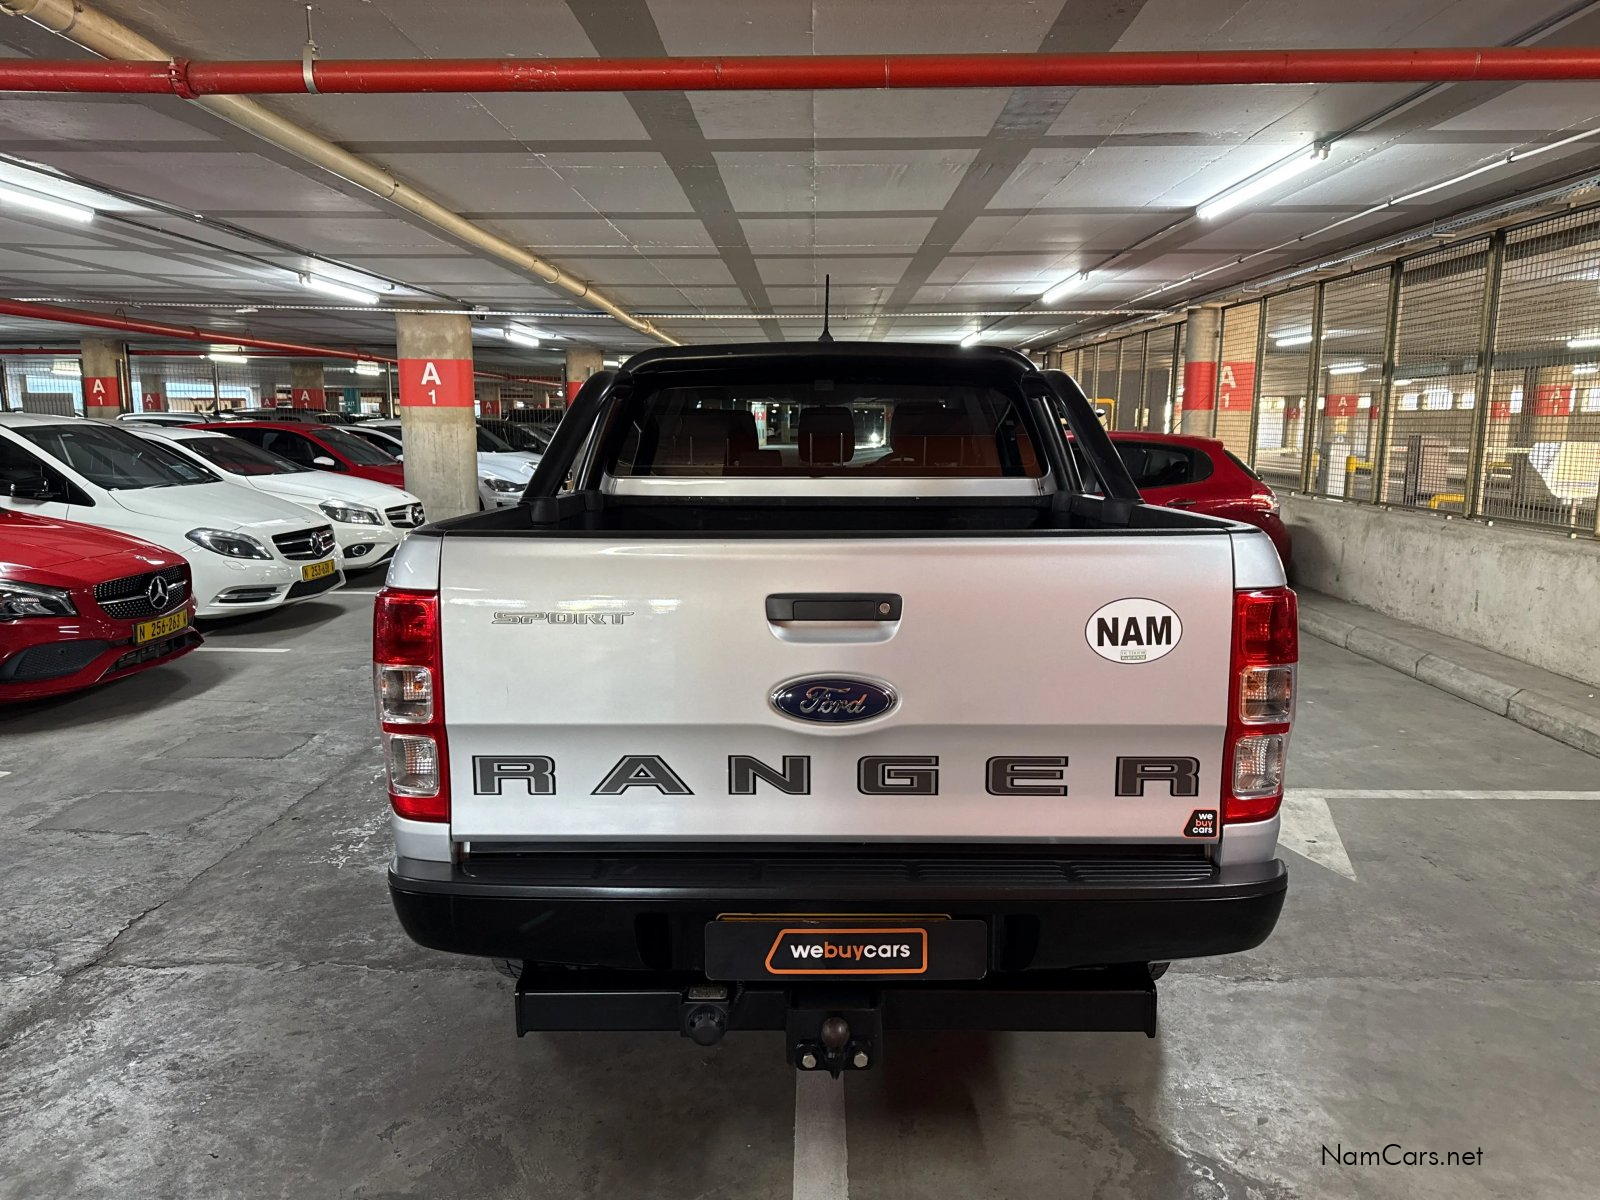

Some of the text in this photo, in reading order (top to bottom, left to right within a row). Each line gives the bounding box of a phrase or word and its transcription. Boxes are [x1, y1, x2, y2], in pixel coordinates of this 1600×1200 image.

[421, 362, 442, 385] A
[1219, 365, 1237, 389] A
[92, 378, 106, 394] A
[97, 395, 104, 406] 1
[145, 393, 154, 403] A
[300, 390, 310, 401] A
[428, 389, 436, 405] 1
[1221, 392, 1230, 408] 1
[1338, 396, 1348, 407] A
[491, 612, 635, 624] SPORT
[139, 625, 145, 641] N
[151, 614, 180, 637] 256-263
[1097, 616, 1172, 646] NAM
[800, 686, 868, 713] Ford
[472, 755, 1200, 797] RANGER
[1195, 819, 1213, 828] buy
[790, 941, 911, 960] webuycars
